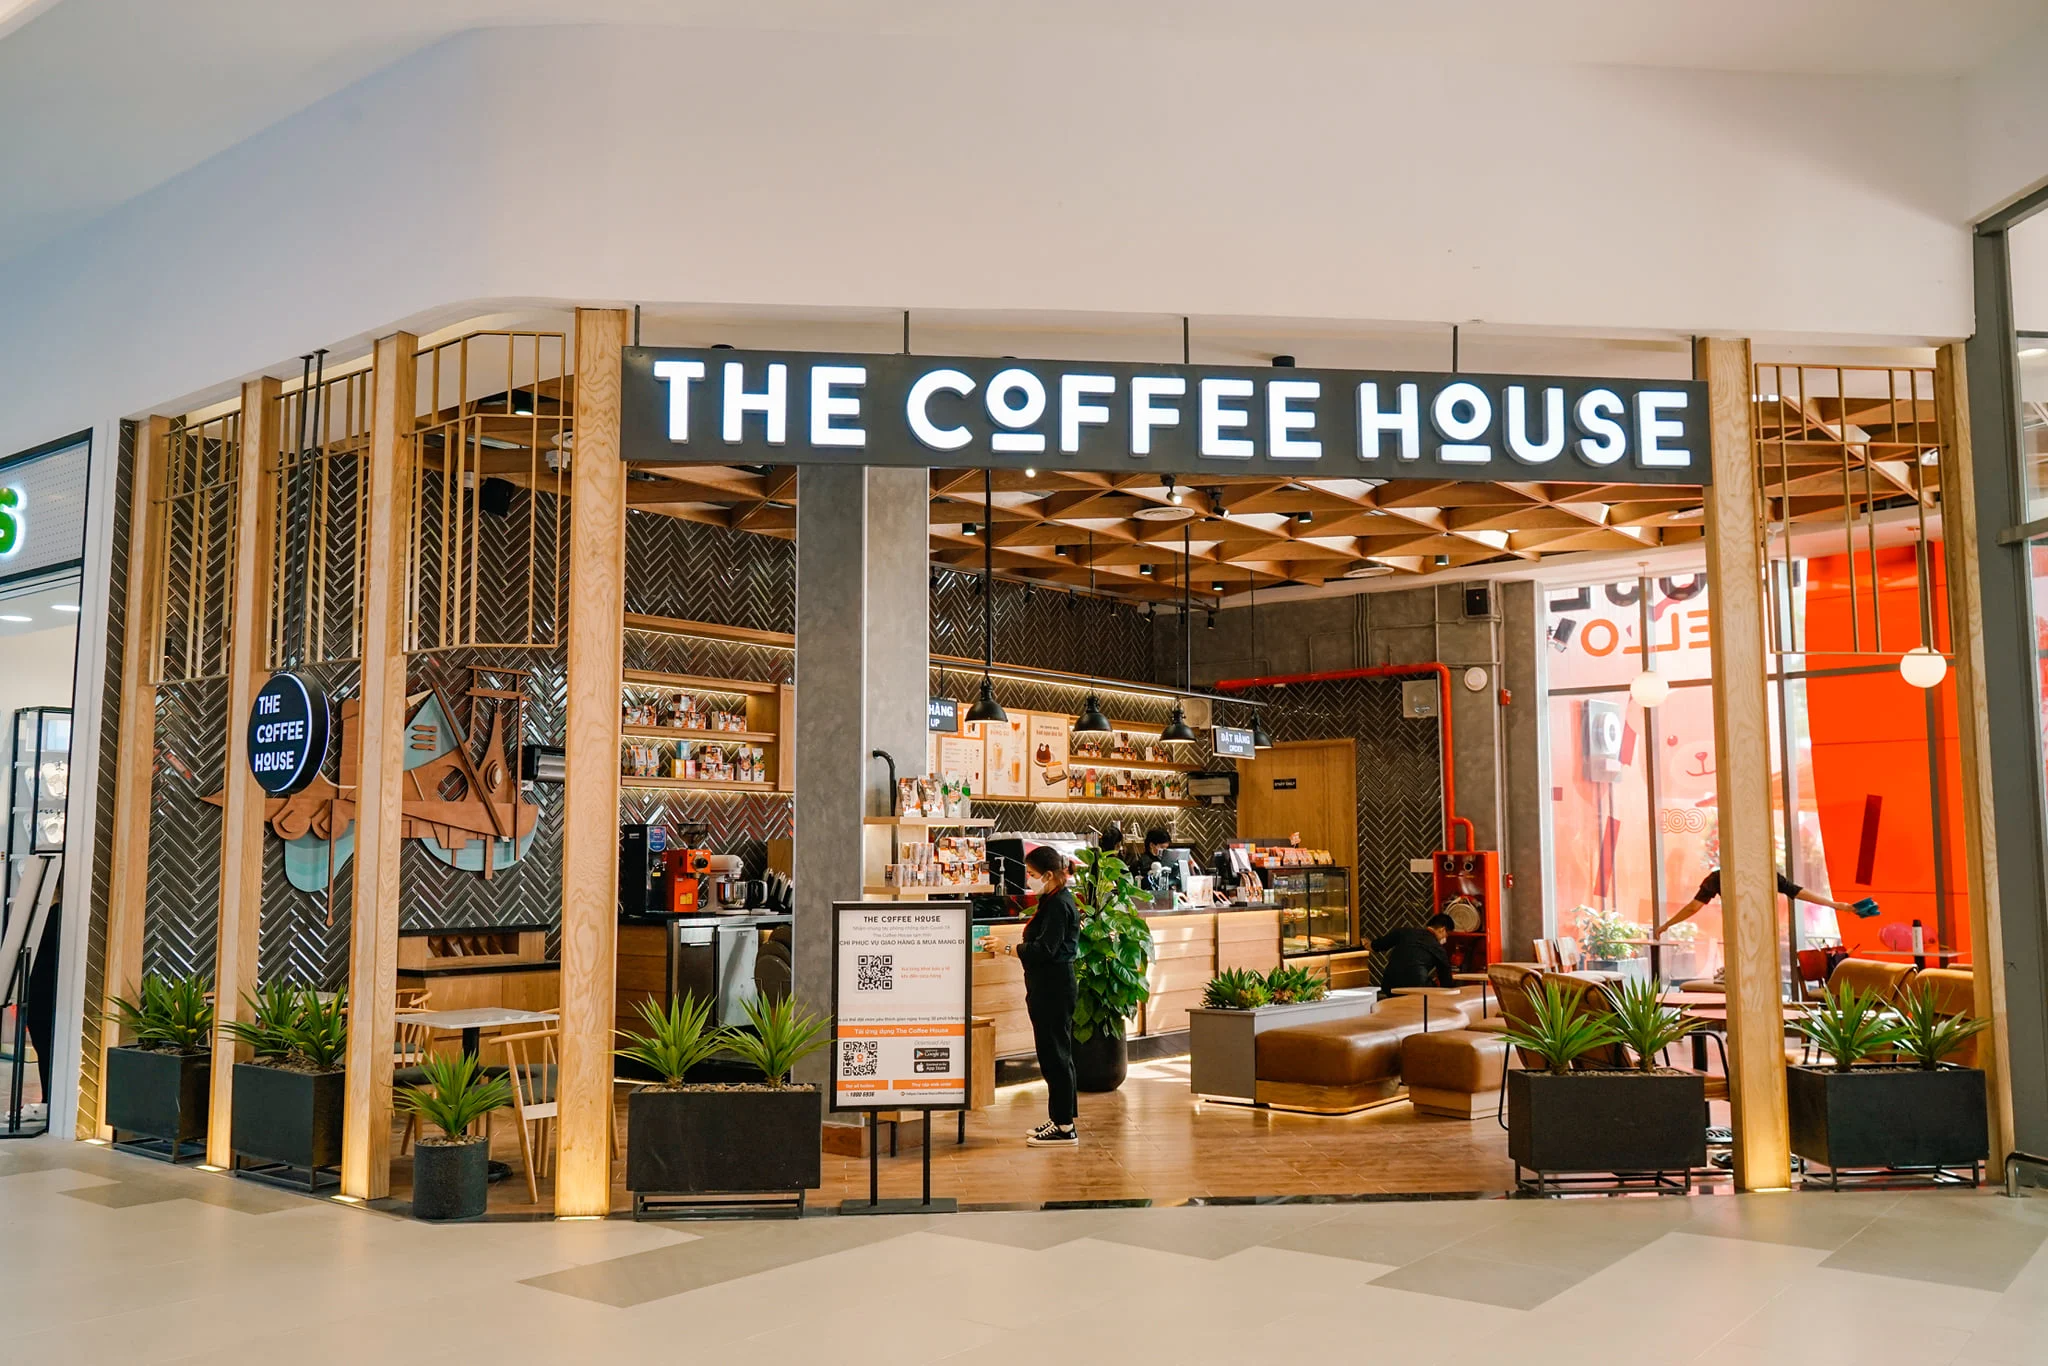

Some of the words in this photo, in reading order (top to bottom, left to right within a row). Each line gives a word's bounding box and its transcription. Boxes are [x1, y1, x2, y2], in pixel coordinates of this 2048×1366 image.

[652, 360, 867, 447] THE
[905, 368, 1323, 459] COFFEE
[1359, 381, 1692, 467] HOUSE
[258, 695, 281, 715] THE
[257, 720, 304, 743] COFFEE
[930, 718, 940, 727] UP
[1234, 733, 1250, 744] HÀNG
[255, 751, 294, 772] HOUSE
